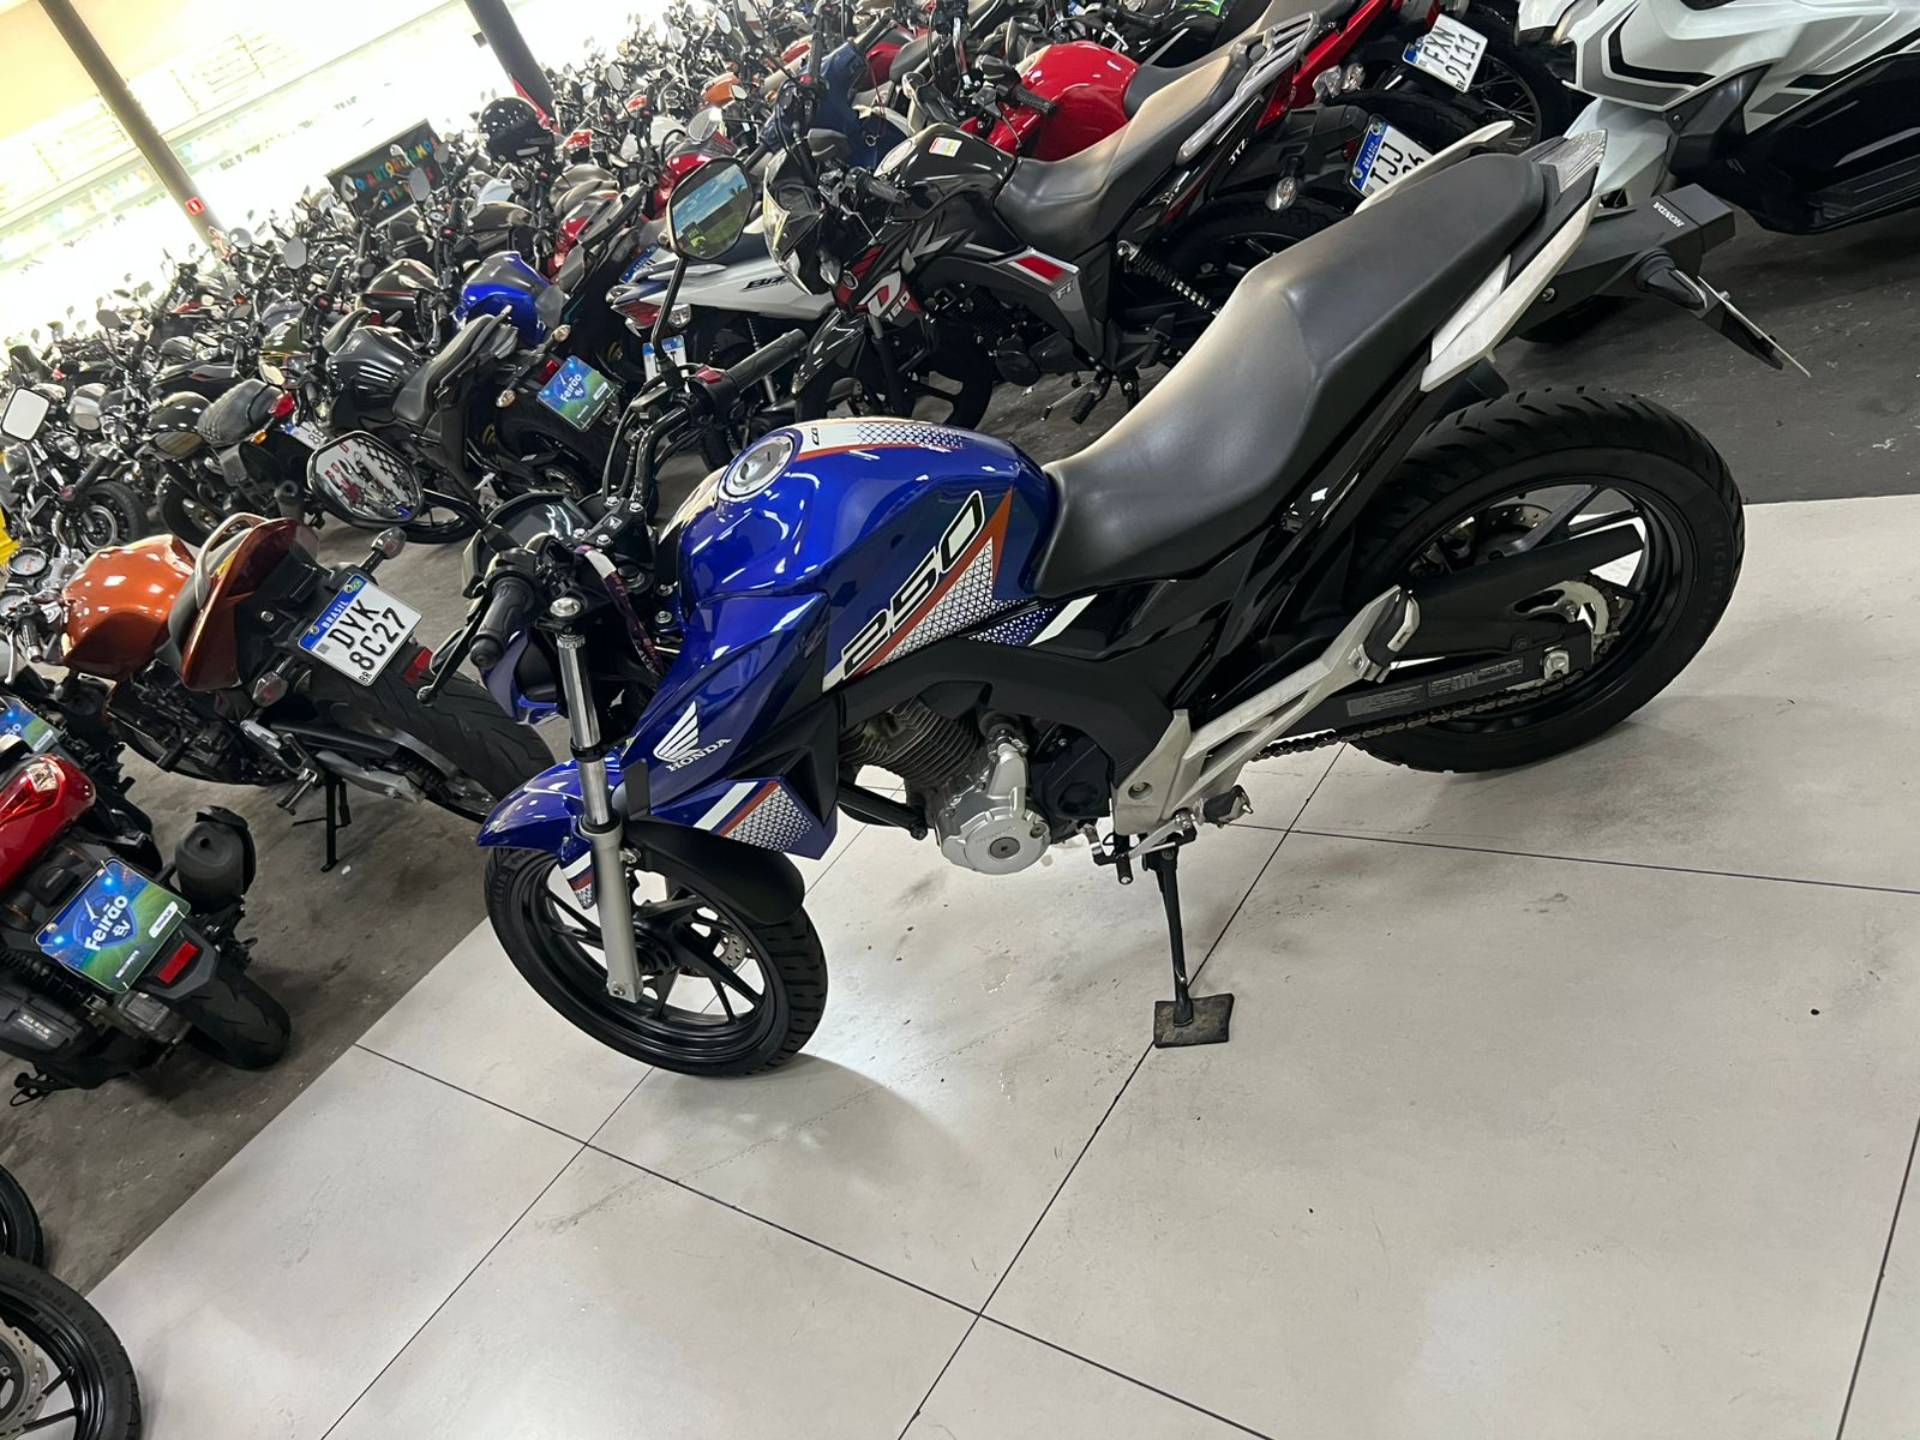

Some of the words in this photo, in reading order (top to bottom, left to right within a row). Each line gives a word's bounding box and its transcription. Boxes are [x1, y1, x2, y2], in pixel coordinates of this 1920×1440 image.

[1423, 25, 1456, 64] FXN
[1370, 141, 1404, 185] TJJ
[1652, 201, 1685, 228] HONDA
[560, 374, 582, 402] Feirão
[840, 490, 985, 680] 250
[321, 599, 349, 629] BRASIL
[327, 599, 380, 650] DYK
[349, 607, 406, 671] 8C27
[665, 738, 732, 772] HONDA
[84, 895, 128, 951] Feirão
